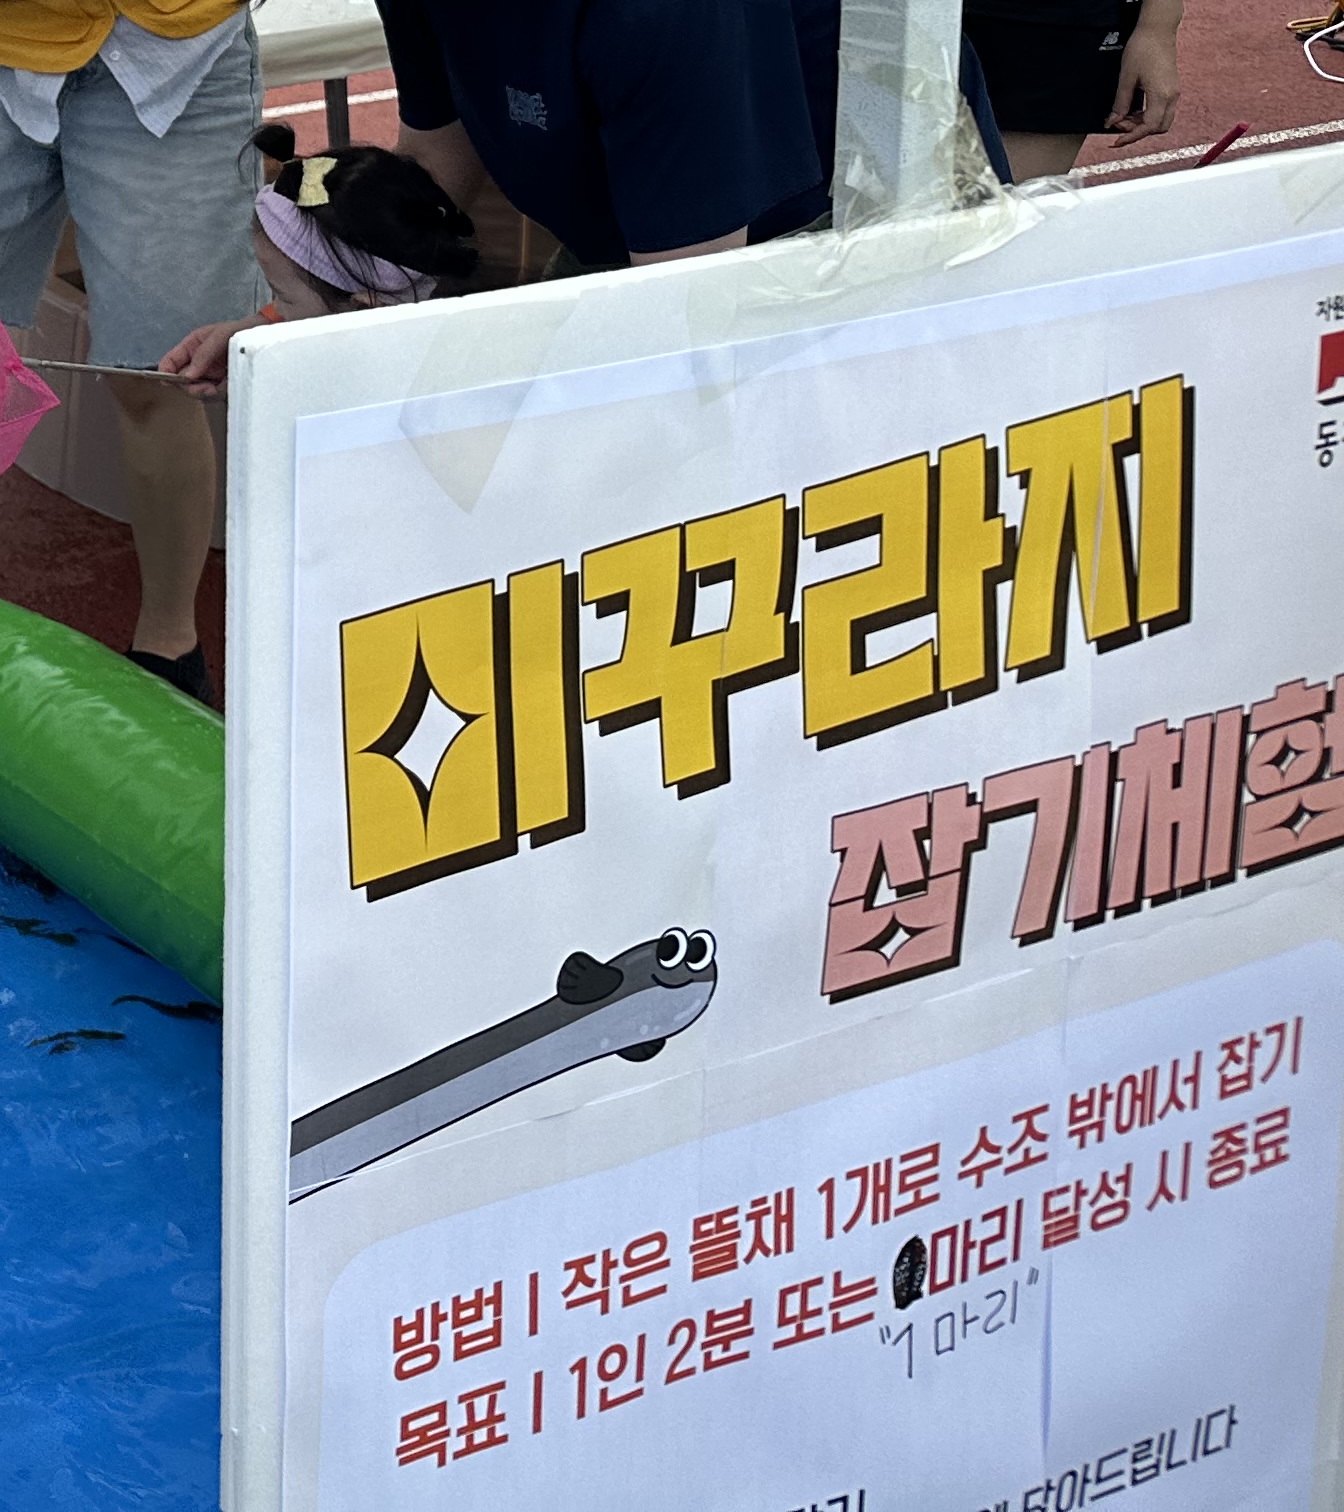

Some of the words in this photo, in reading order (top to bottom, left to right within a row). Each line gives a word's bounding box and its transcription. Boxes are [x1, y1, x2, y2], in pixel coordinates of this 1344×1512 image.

[1315, 419, 1344, 469] 동
[340, 374, 1195, 901] 미꾸라지
[392, 1280, 503, 1381] 방법
[561, 1231, 671, 1316] 작은
[689, 1187, 795, 1282] 뜰채
[817, 1142, 940, 1240] 1개로
[958, 1103, 1051, 1189] 수조
[1067, 1050, 1204, 1150] 밖에서
[1216, 1016, 1304, 1101] 잡기
[395, 1380, 509, 1468] 목표
[569, 1333, 647, 1420] 1인
[663, 1298, 754, 1386] 2분
[773, 1271, 878, 1351] 또는
[892, 1198, 1024, 1310] 마리
[1041, 1162, 1134, 1251] 달성
[1146, 1141, 1193, 1212] 시
[1206, 1106, 1291, 1191] 종료
